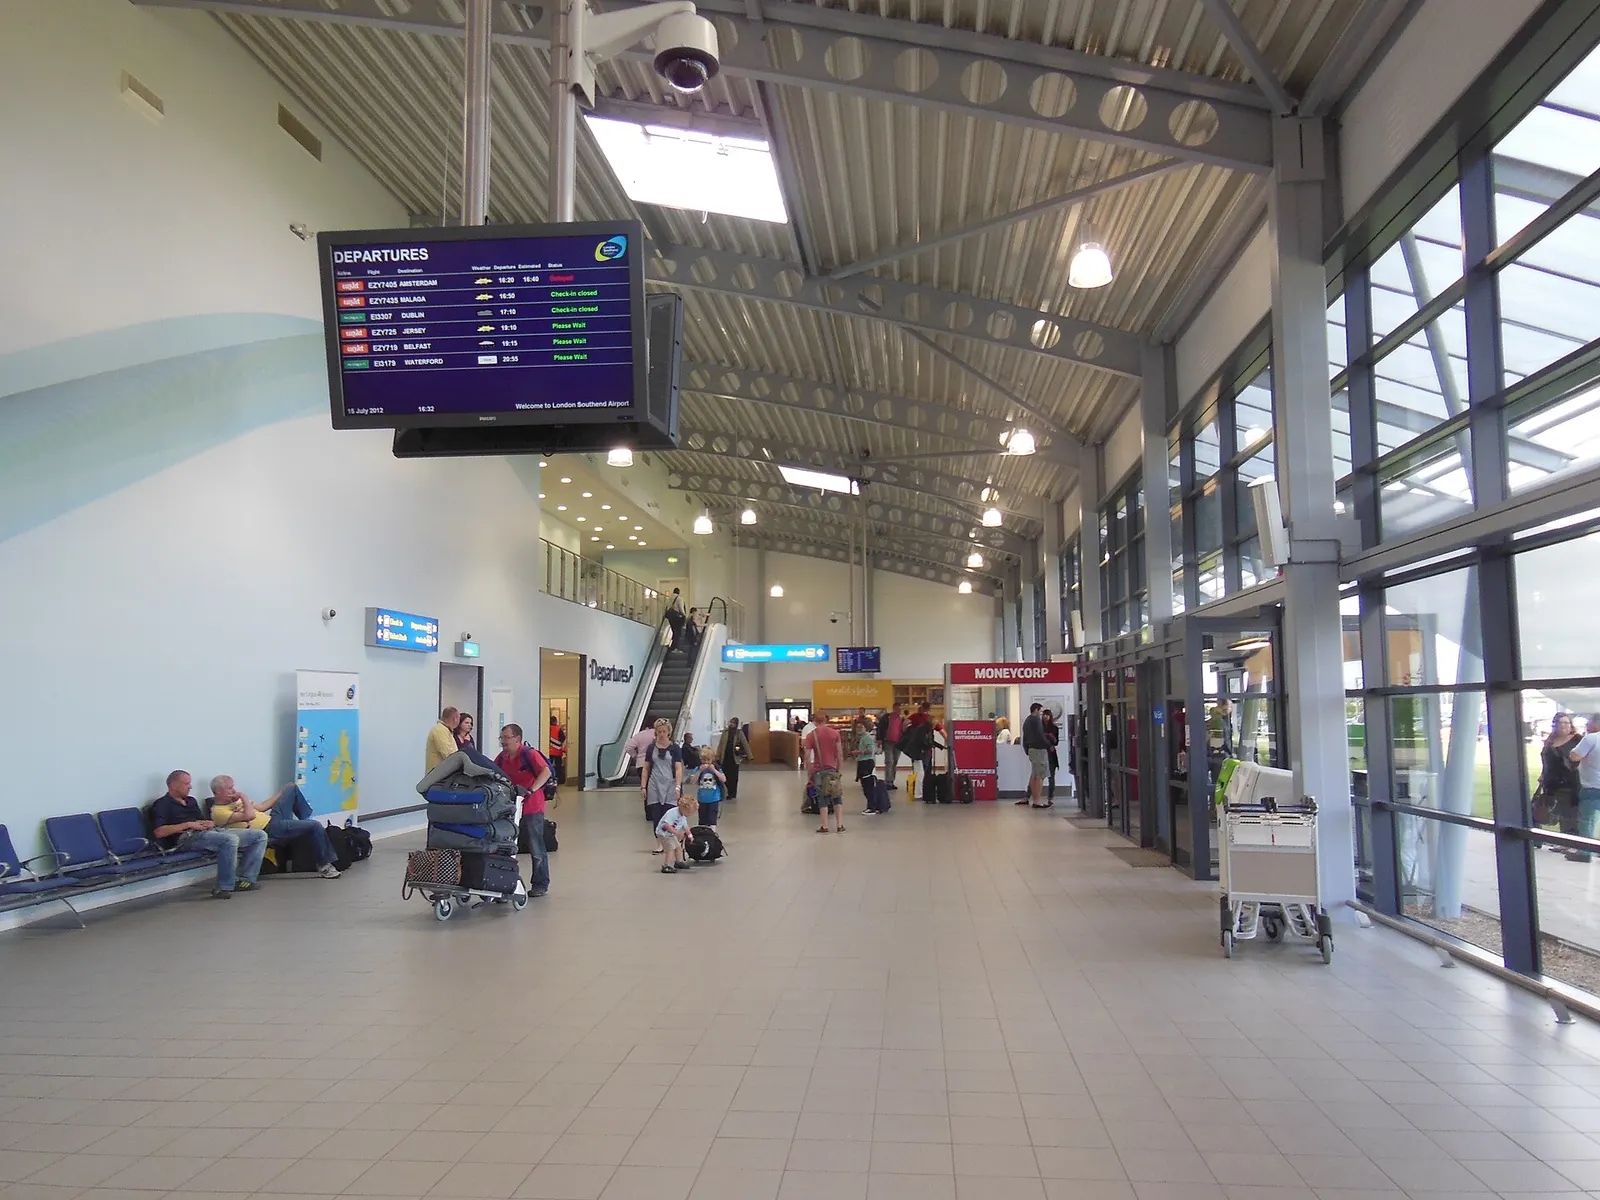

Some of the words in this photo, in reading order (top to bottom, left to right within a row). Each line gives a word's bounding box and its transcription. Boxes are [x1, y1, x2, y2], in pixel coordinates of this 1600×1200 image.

[333, 248, 429, 263] DEPARTURES
[368, 281, 398, 289] EZY7405
[399, 279, 438, 288] AMSTERDAM
[369, 296, 399, 305] EZY7435
[400, 296, 427, 304] MALAGA
[550, 290, 577, 298] Check-in
[500, 308, 517, 316] 17:10
[551, 306, 577, 314] Check-in
[578, 305, 599, 313] closed
[402, 327, 427, 335] JERSEY
[553, 338, 573, 346] Please
[404, 358, 444, 366] WATERFORD
[502, 355, 519, 363] 20:55
[552, 401, 576, 409] London
[577, 400, 607, 408] Southend
[608, 400, 630, 408] Airport
[356, 407, 369, 415] July
[369, 406, 384, 414] 2012
[591, 658, 630, 687] Departures
[974, 667, 1049, 679] MONEYCORP
